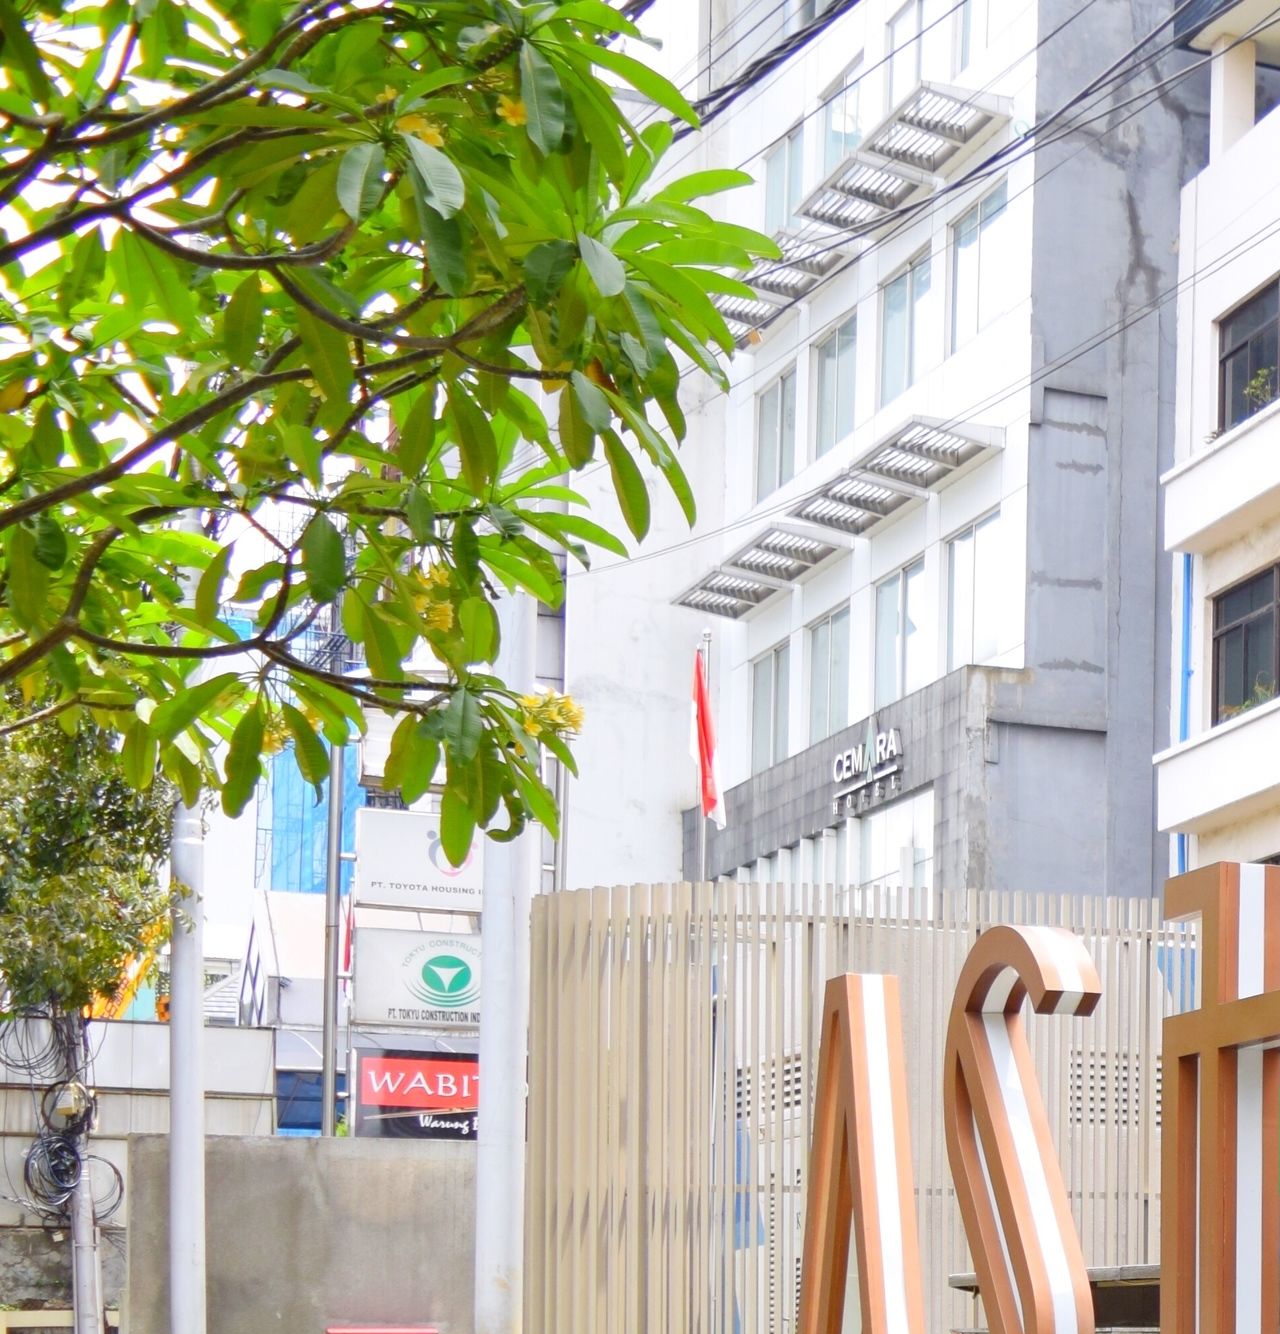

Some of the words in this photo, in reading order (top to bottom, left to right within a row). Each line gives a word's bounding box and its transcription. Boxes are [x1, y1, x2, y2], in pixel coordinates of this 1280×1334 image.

[833, 715, 899, 783] CEMARA
[832, 775, 896, 815] HOTEL
[371, 881, 386, 889] PT.
[390, 882, 428, 892] TOYOTA
[431, 885, 475, 895] HOUSING
[402, 944, 426, 968] TOKYU
[387, 1008, 397, 1019] PT.
[399, 1008, 420, 1020] TOKYU
[421, 1010, 469, 1022] CONSTRUCTION
[368, 1071, 529, 1099] WABI
[419, 1113, 469, 1135] Warung
